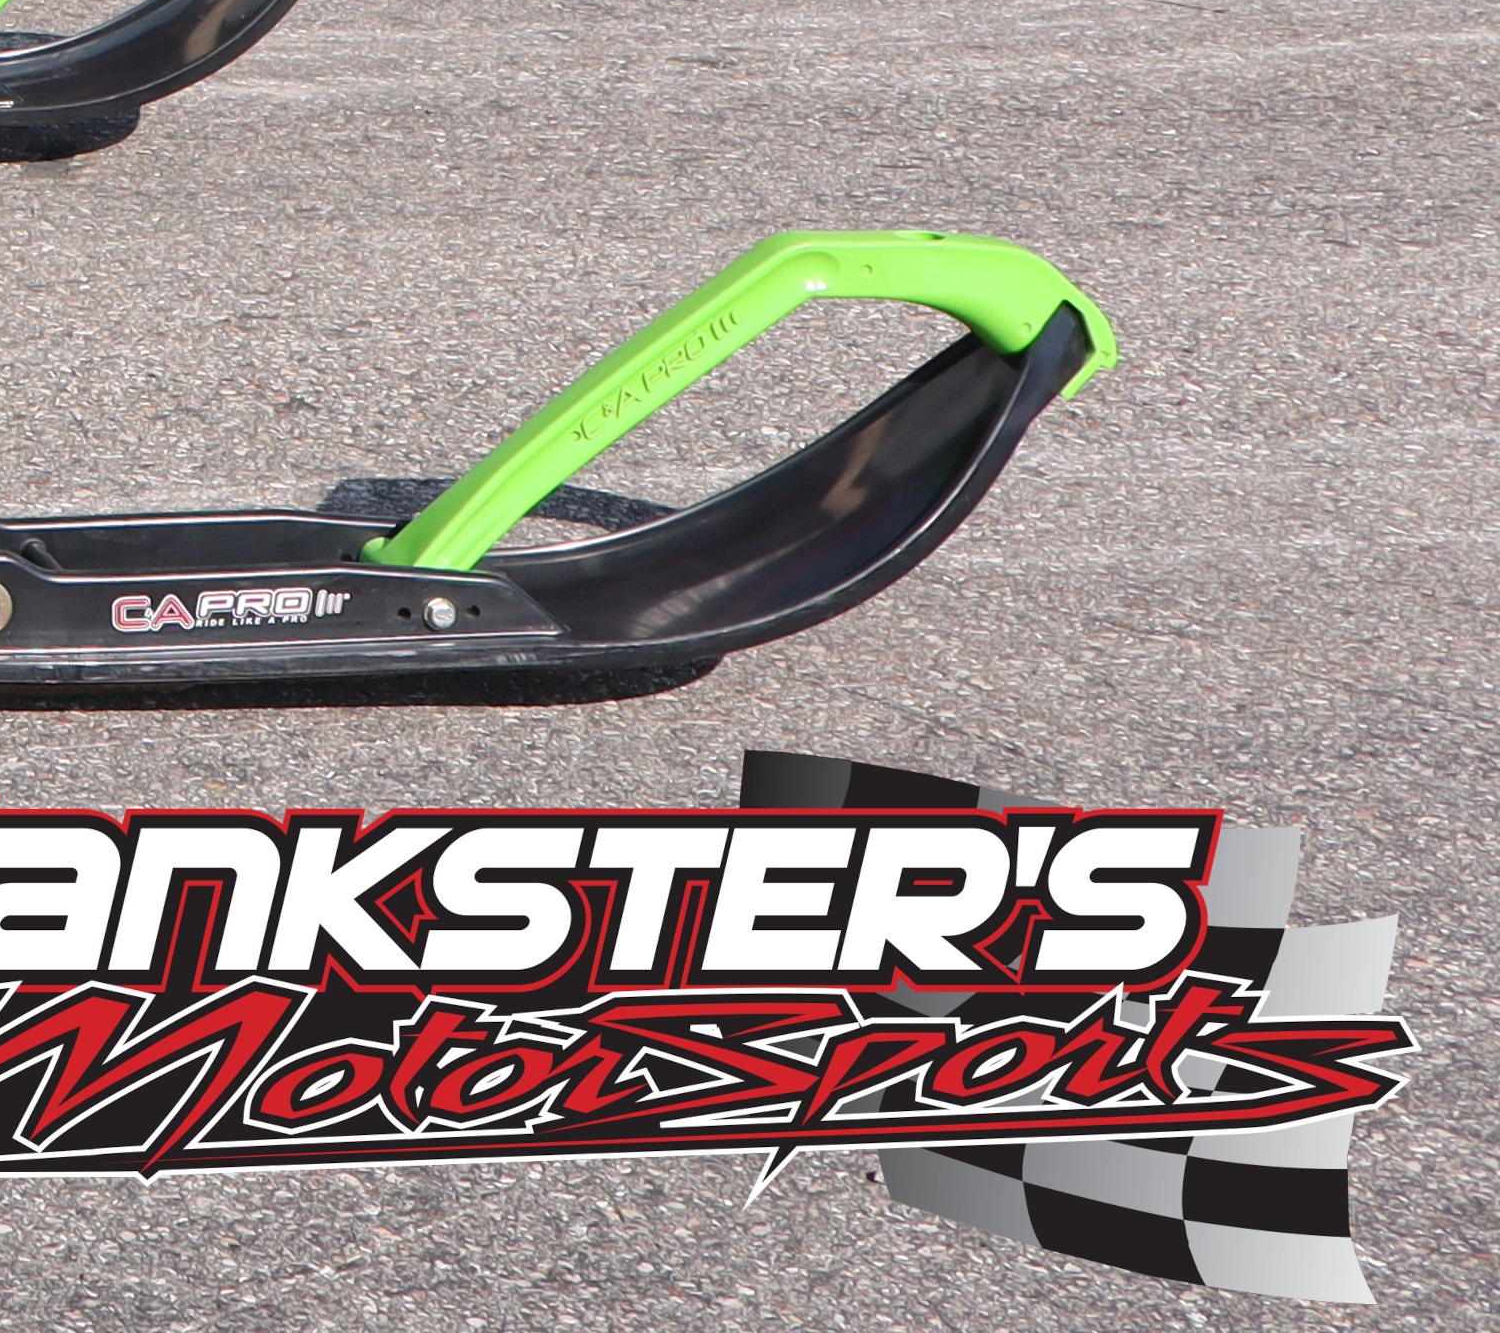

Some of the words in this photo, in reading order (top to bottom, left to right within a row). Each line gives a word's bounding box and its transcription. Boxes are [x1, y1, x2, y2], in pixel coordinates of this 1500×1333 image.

[196, 587, 313, 619] PRO
[195, 618, 225, 628] RIDE
[232, 616, 261, 626] LIKE
[267, 615, 276, 624] A
[281, 614, 308, 624] PRO
